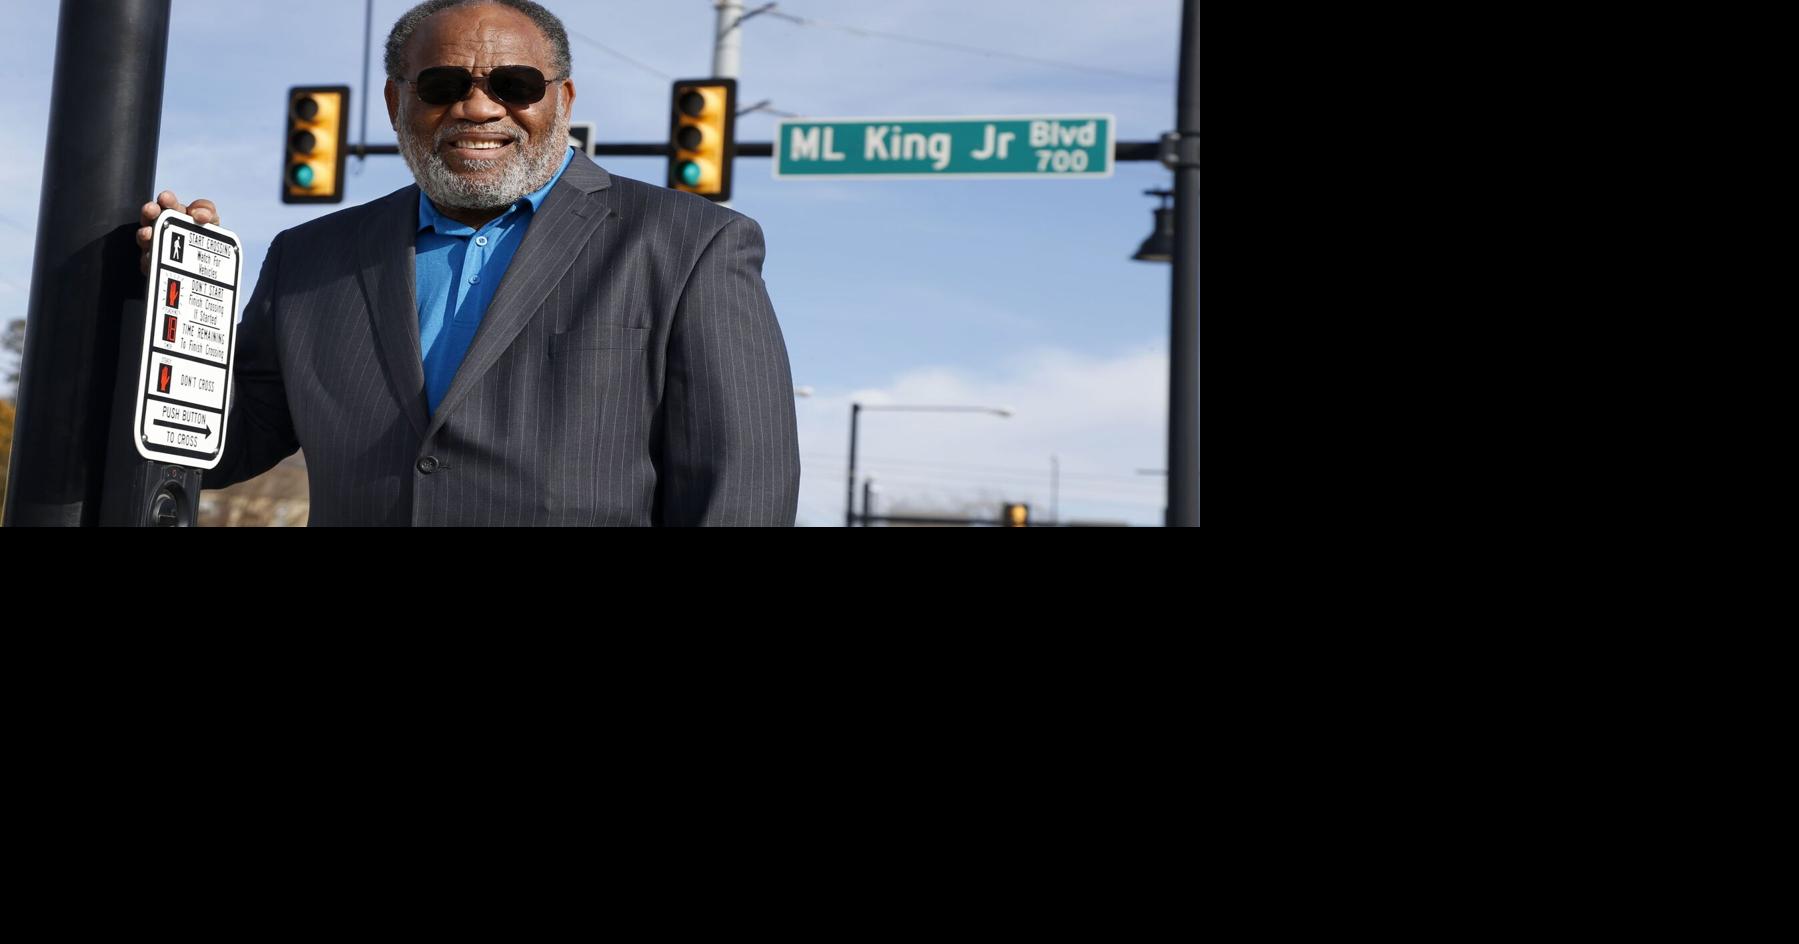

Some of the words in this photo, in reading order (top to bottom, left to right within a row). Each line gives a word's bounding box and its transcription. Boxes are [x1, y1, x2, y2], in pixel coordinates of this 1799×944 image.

[790, 126, 845, 162] ML
[864, 125, 952, 170] King
[970, 124, 1015, 160] Jr
[1029, 120, 1097, 147] Blvd
[1035, 149, 1089, 172] 700
[189, 232, 205, 247] START
[206, 238, 231, 257] CROSSING
[209, 284, 224, 299] START
[205, 298, 224, 317] Crossing
[182, 323, 195, 337] TIME
[197, 327, 225, 345] REMAINING
[205, 343, 225, 362] Crossing
[180, 374, 197, 388] DON'T
[199, 378, 215, 393] CROSS
[162, 405, 181, 420] PUSH
[182, 409, 207, 425] BUTTON
[166, 430, 176, 444] TO
[177, 433, 199, 448] CROSS
